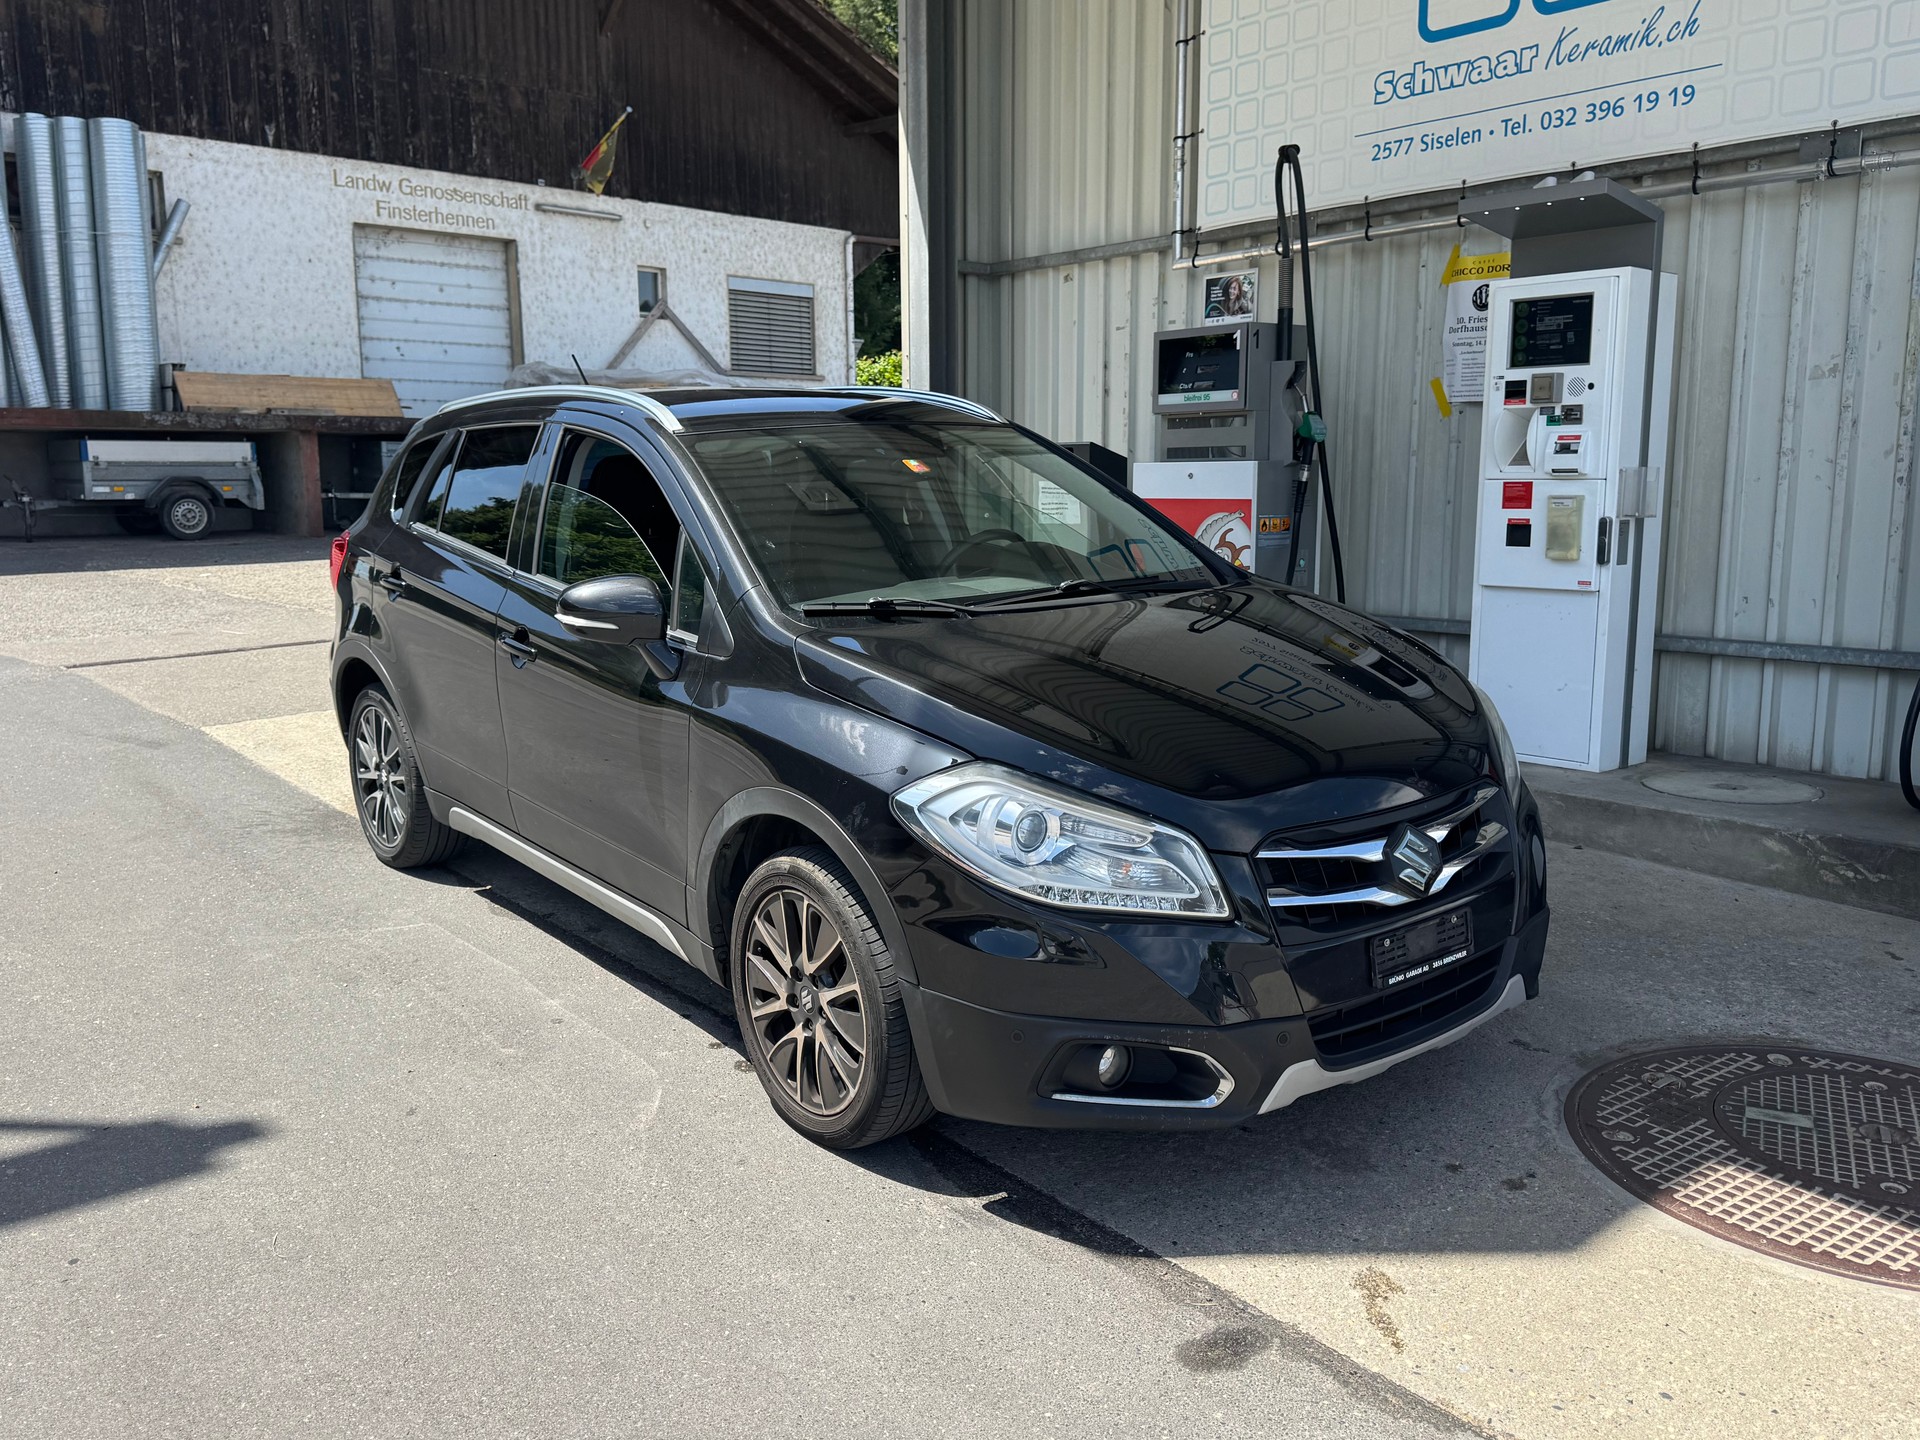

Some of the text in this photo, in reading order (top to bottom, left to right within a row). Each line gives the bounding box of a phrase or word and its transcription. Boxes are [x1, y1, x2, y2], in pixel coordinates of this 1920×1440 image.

[1373, 0, 1701, 105] Schwaar Keramik.ch
[1371, 84, 1696, 162] 2577 Siselen Tel. 032 396 19 19
[332, 168, 531, 211] Landw. Genossenschaft
[375, 200, 496, 230] Finsterhennen
[1451, 266, 1485, 278] CHICCO
[1233, 329, 1241, 350] 1
[1253, 328, 1260, 349] 1
